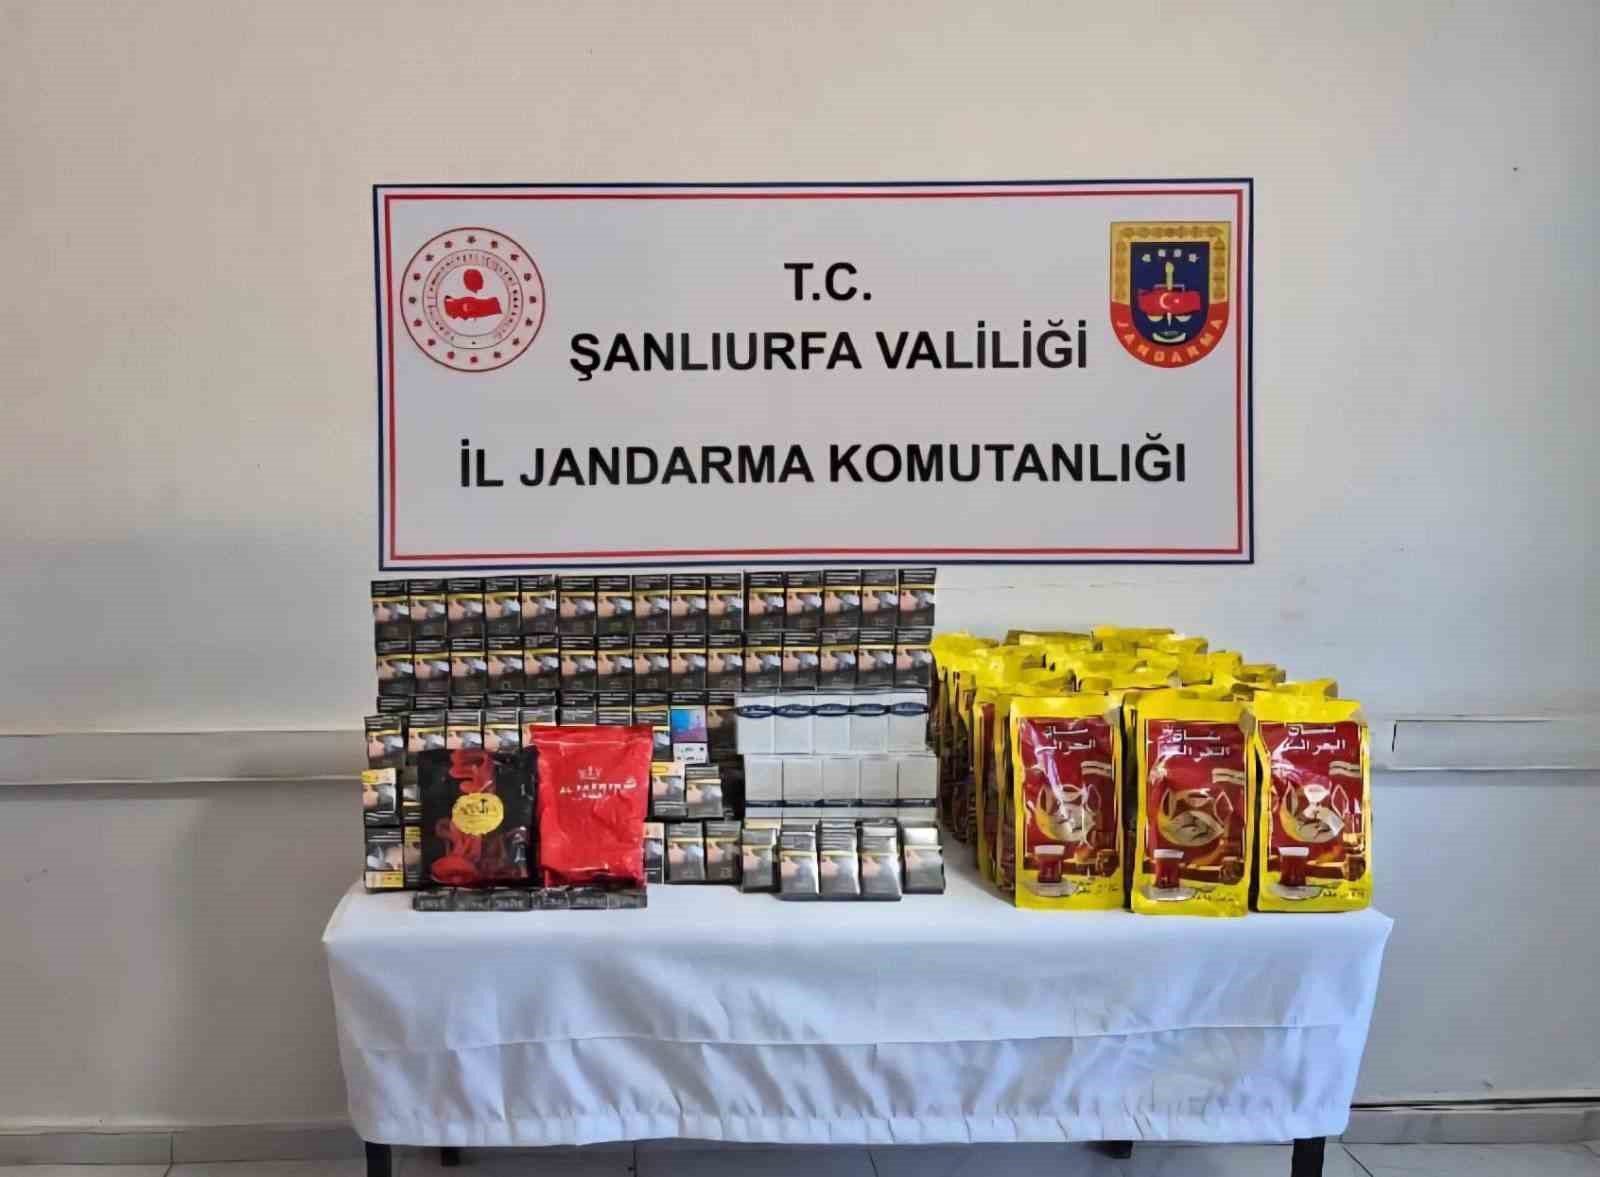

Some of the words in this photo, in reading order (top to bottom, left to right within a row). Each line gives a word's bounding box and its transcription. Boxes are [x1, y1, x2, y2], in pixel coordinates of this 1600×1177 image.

[784, 263, 871, 301] T.C.
[570, 332, 861, 381] ŞANLIURFA
[876, 319, 1087, 369] VALİLİĞİ
[1116, 319, 1223, 363] JANDARMA
[461, 439, 503, 487] İL
[520, 444, 814, 486] JANDARMA
[830, 432, 1186, 482] KOMUTANLIĞI
